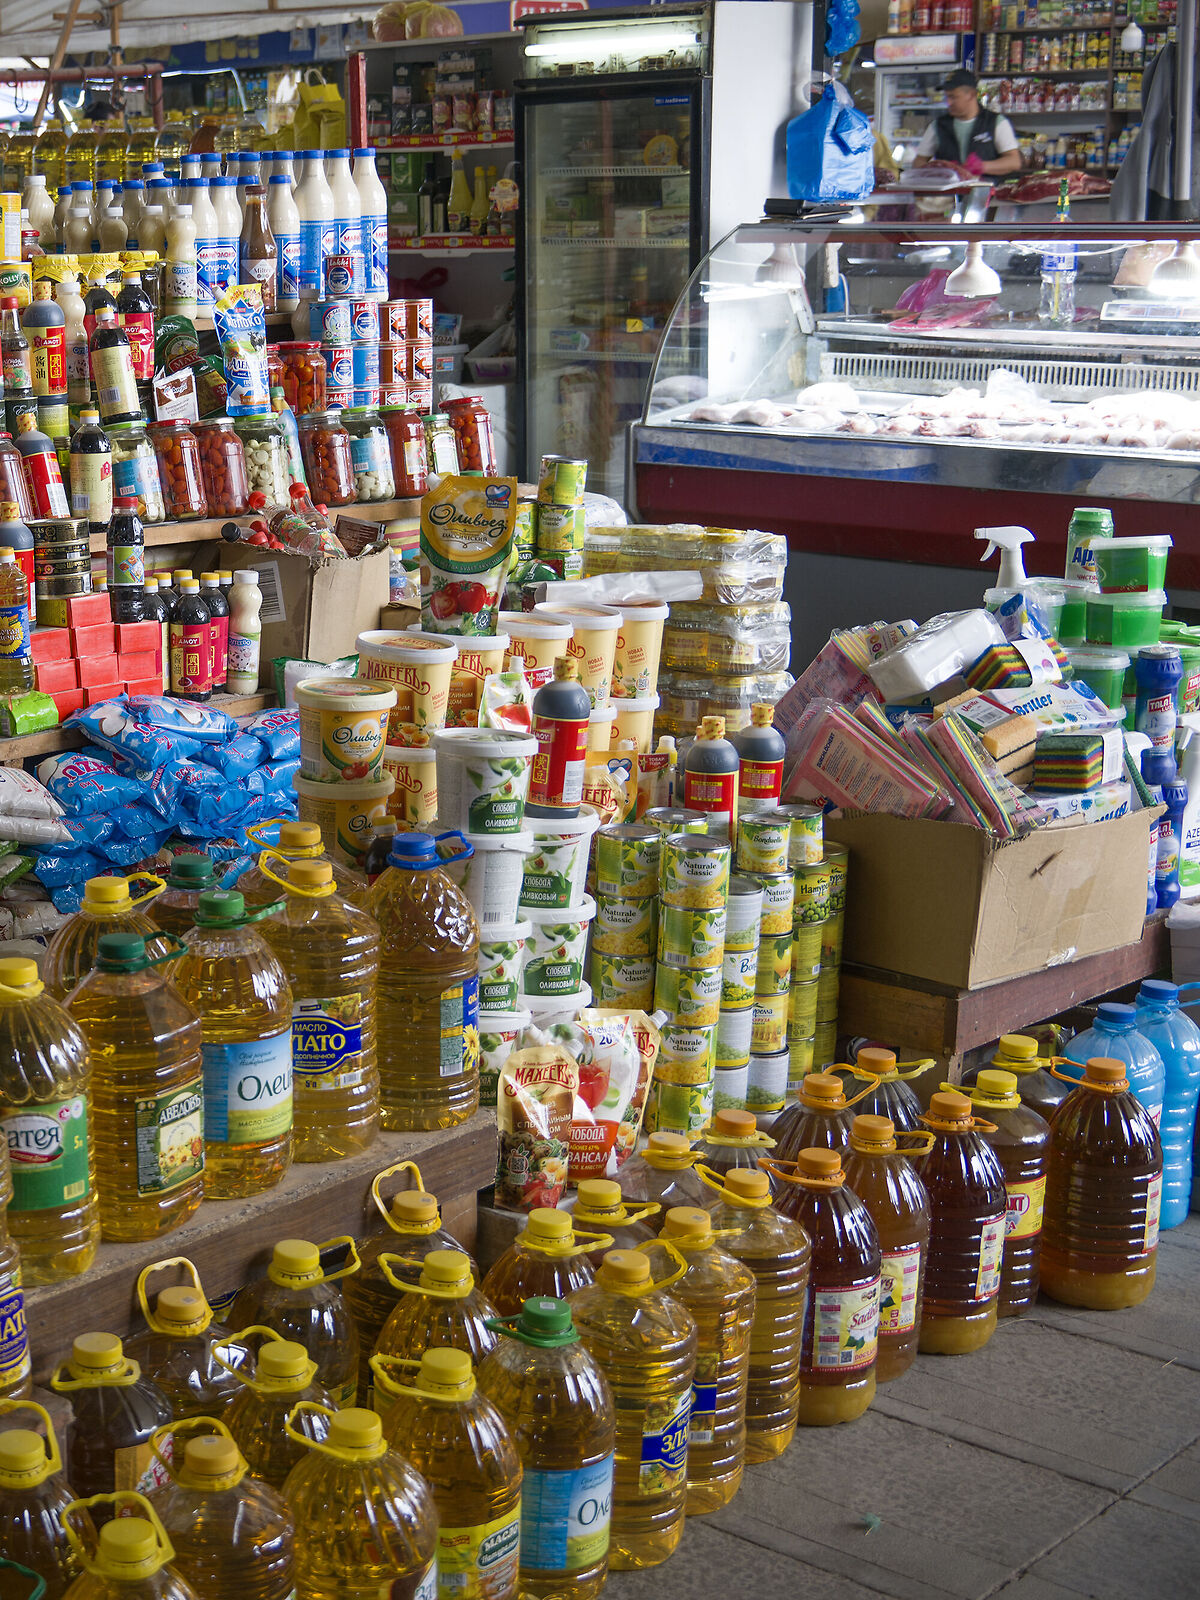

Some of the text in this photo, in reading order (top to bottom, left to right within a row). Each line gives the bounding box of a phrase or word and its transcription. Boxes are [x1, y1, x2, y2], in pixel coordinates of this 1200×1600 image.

[329, 258, 349, 267] Lakki
[335, 350, 353, 359] Lakk
[429, 503, 509, 538] Оливьез
[452, 654, 484, 676] ЕЕВЪ
[366, 661, 419, 688] МАХЕЕВЪ
[1013, 693, 1053, 716] Briller
[1150, 700, 1170, 711] TALA
[332, 726, 382, 748] Оливьез
[583, 788, 613, 805] ЕЕВЪ
[485, 817, 519, 828] ОЛИВКОВЫЙ
[753, 834, 783, 845] Bonduelle
[683, 861, 717, 871] Naturale
[765, 890, 793, 898] Naturale
[801, 883, 829, 895] Натуре
[604, 909, 637, 920] Naturale
[545, 966, 571, 976] СЛОБОДА
[621, 968, 651, 977] Naturale
[540, 978, 573, 989] ОЛИВКОВЫЙ
[625, 975, 649, 983] classic
[294, 1023, 327, 1033] МАСЛО
[669, 1038, 703, 1047] Naturale
[672, 1045, 698, 1053] classic
[516, 1062, 571, 1087] МАХЕЕВЪ
[237, 1072, 294, 1102] Олей
[159, 1094, 203, 1125] АВЕДОВЪ
[238, 1119, 260, 1128] МАСЛО
[661, 1426, 688, 1453] ЗЛА
